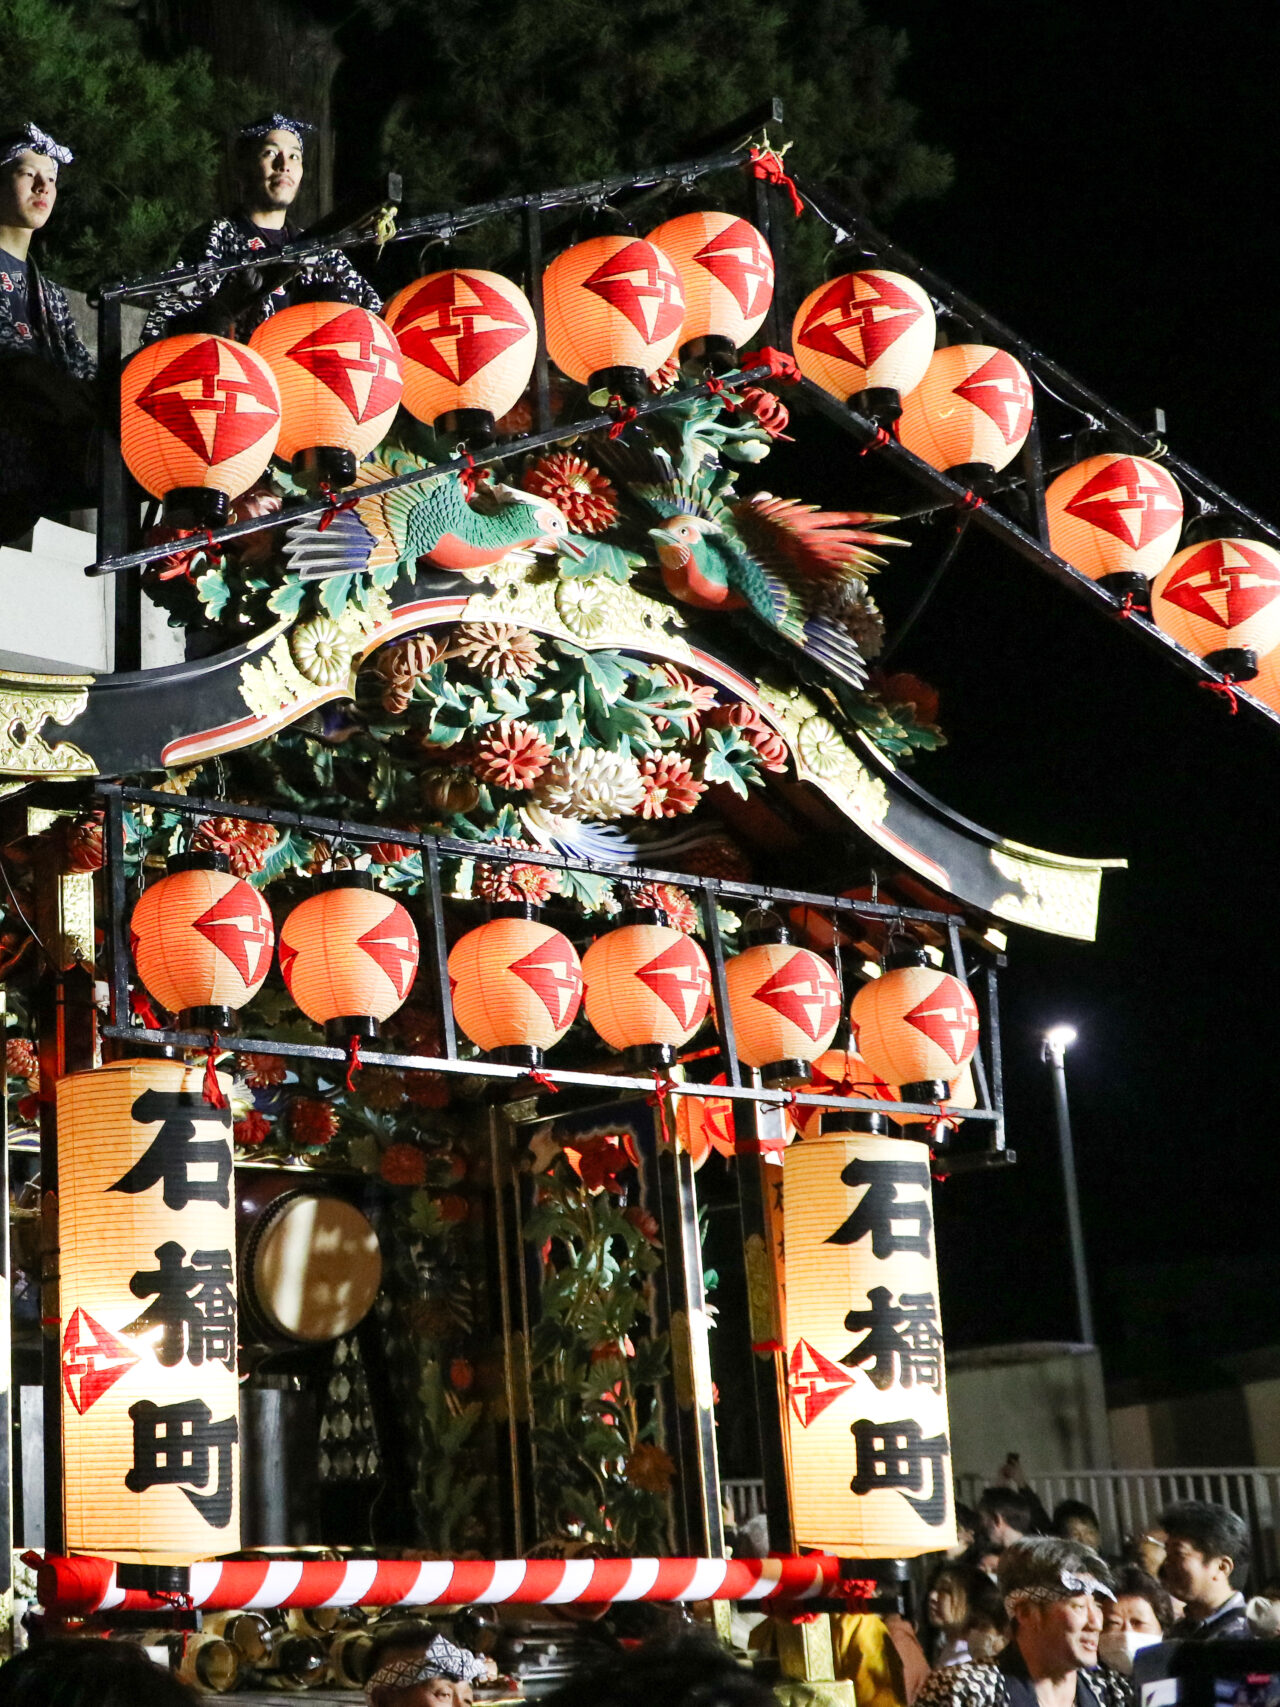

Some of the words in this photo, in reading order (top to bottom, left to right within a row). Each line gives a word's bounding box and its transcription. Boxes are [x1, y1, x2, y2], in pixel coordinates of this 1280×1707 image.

[104, 1088, 239, 1530] 石橋町
[822, 1157, 950, 1528] 石橋町
